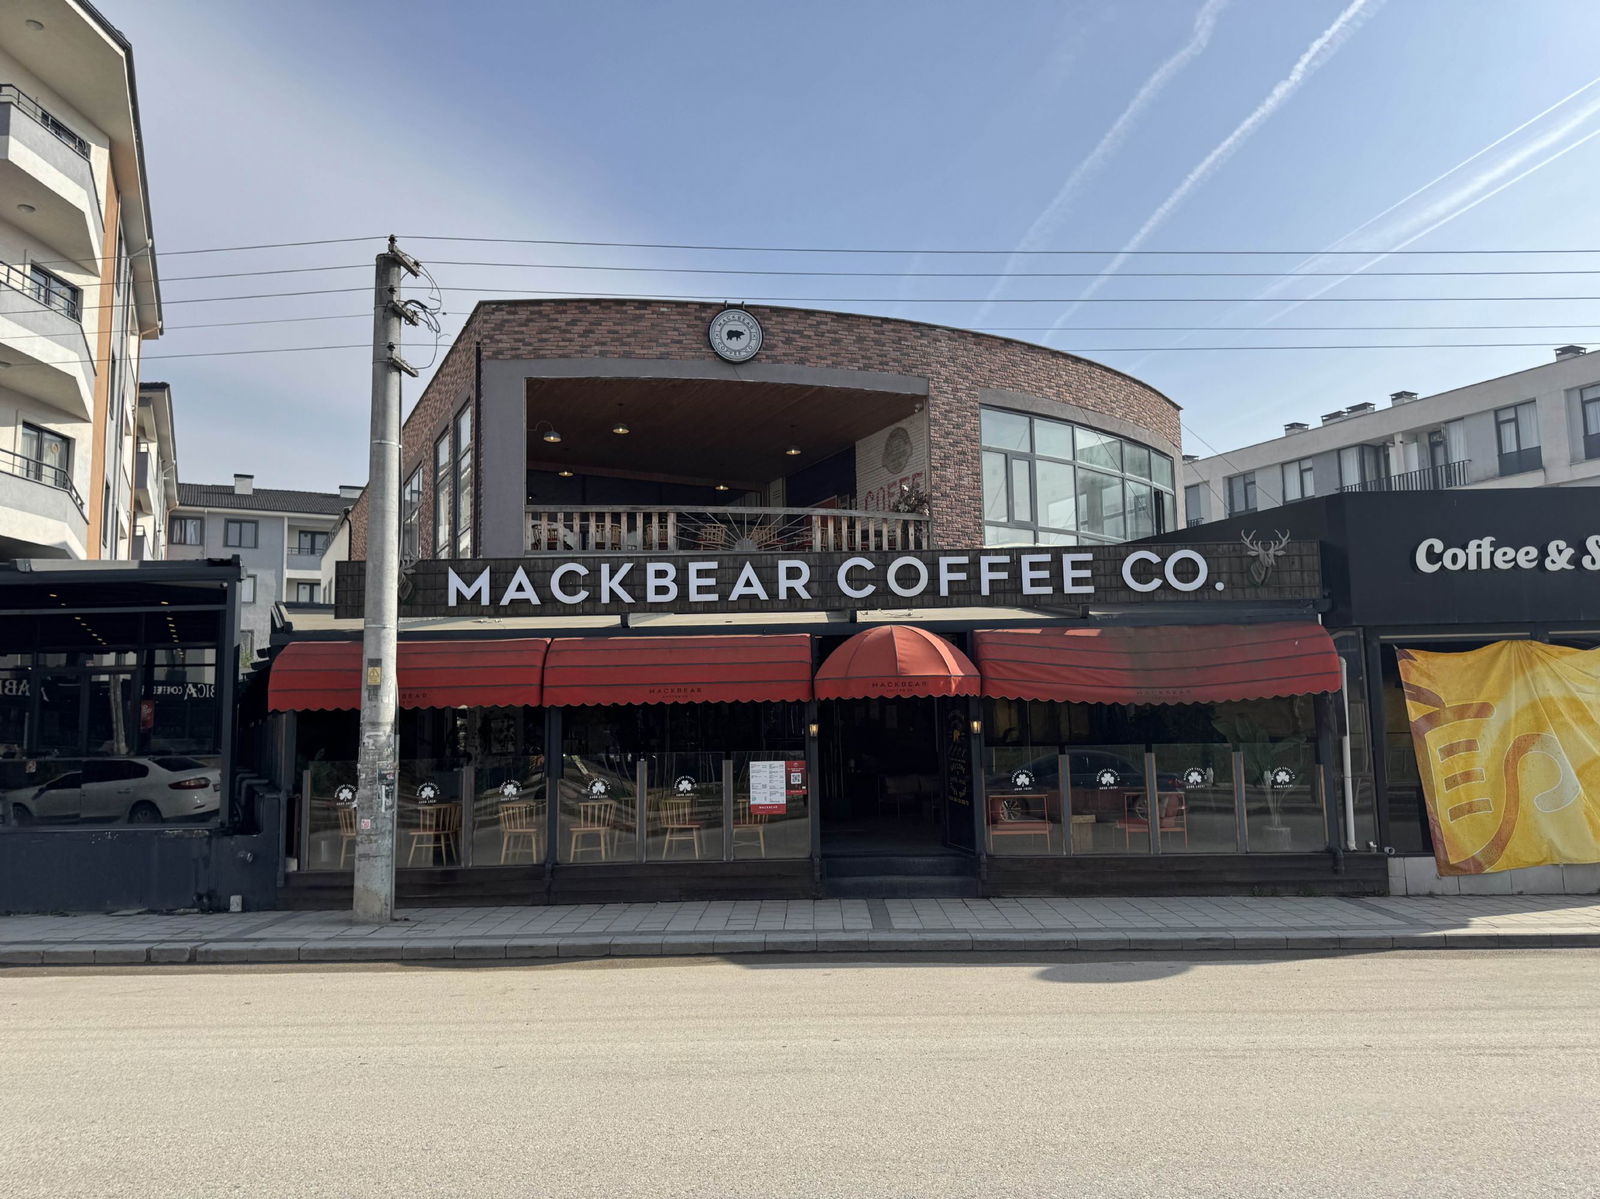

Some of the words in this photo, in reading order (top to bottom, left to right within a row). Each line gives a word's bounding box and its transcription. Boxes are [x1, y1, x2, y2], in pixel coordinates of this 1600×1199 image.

[1415, 535, 1538, 573] Coffee
[1544, 539, 1576, 571] &
[447, 558, 812, 607] MACKBEAR
[837, 553, 1095, 598] COFFEE
[1121, 549, 1226, 592] CO.
[648, 686, 703, 695] MACKBEAR
[871, 681, 927, 689] MACKBEAR
